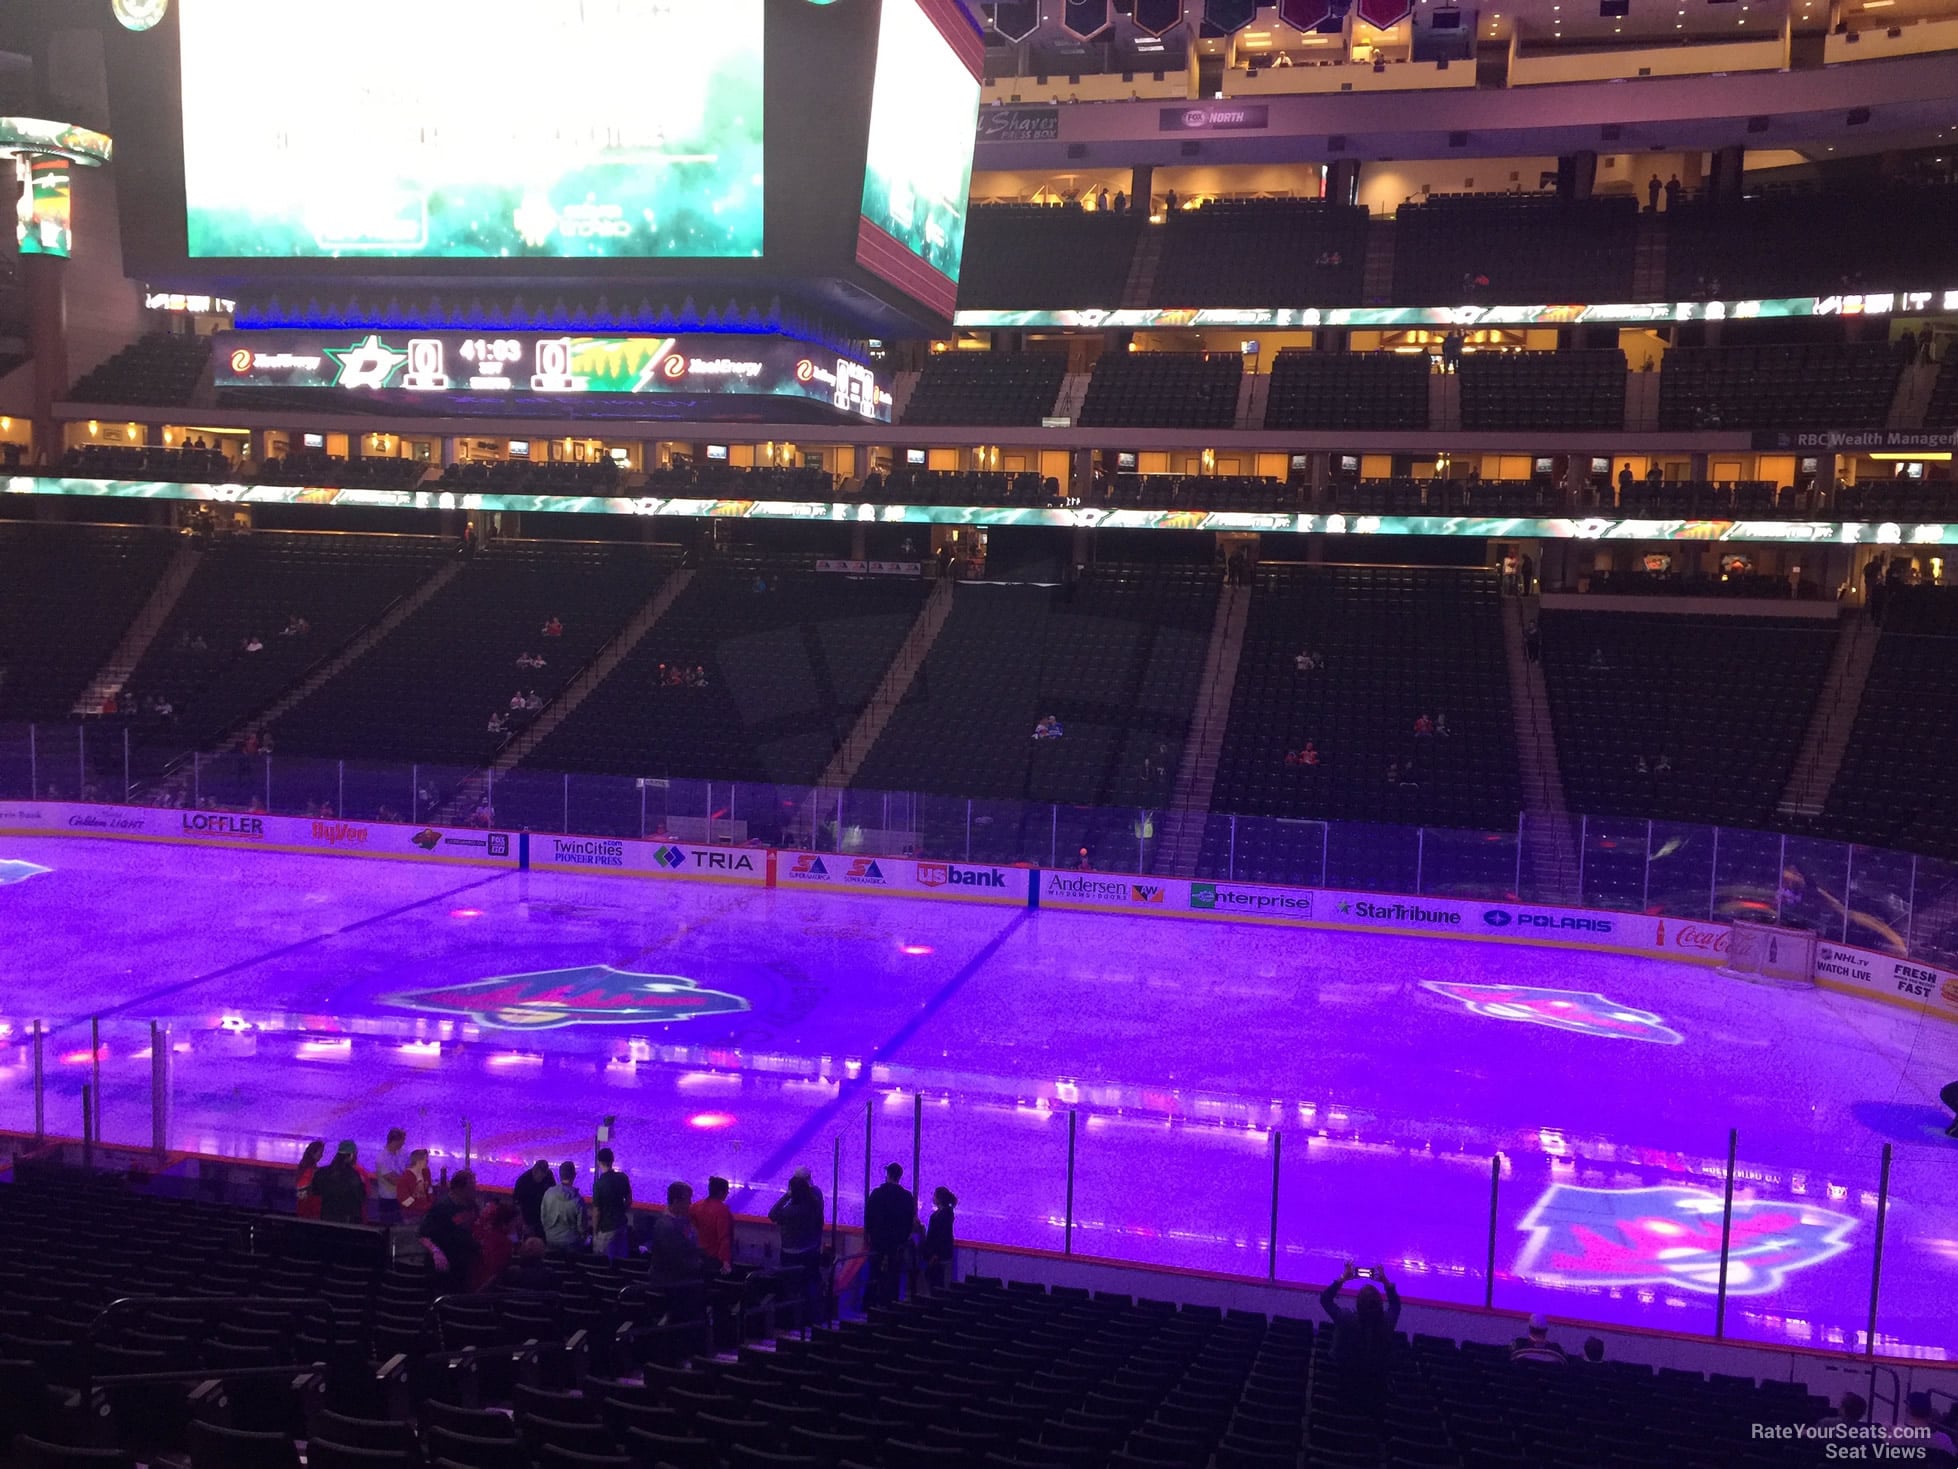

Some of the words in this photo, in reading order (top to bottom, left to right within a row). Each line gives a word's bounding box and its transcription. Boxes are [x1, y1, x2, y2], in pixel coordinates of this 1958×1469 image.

[985, 111, 1057, 135] Shaver
[1209, 112, 1244, 123] NORTH
[1798, 433, 1827, 446] RBC
[1830, 432, 1883, 446] Wealth
[110, 818, 145, 829] LIGHT
[182, 813, 264, 834] LOFFLER
[553, 839, 623, 857] TwinCities
[555, 853, 594, 864] PIONEER
[594, 856, 623, 866] PRESS
[691, 850, 753, 871] TRIA
[1049, 874, 1127, 894] Andersen
[1199, 890, 1310, 909] enterprise
[1355, 901, 1462, 924] StarTribune
[1517, 913, 1612, 933] POLARIS
[1817, 961, 1850, 977] WATCH
[1851, 968, 1872, 982] LIVE
[1894, 964, 1937, 984] FRESH
[1897, 981, 1931, 998] FAST
